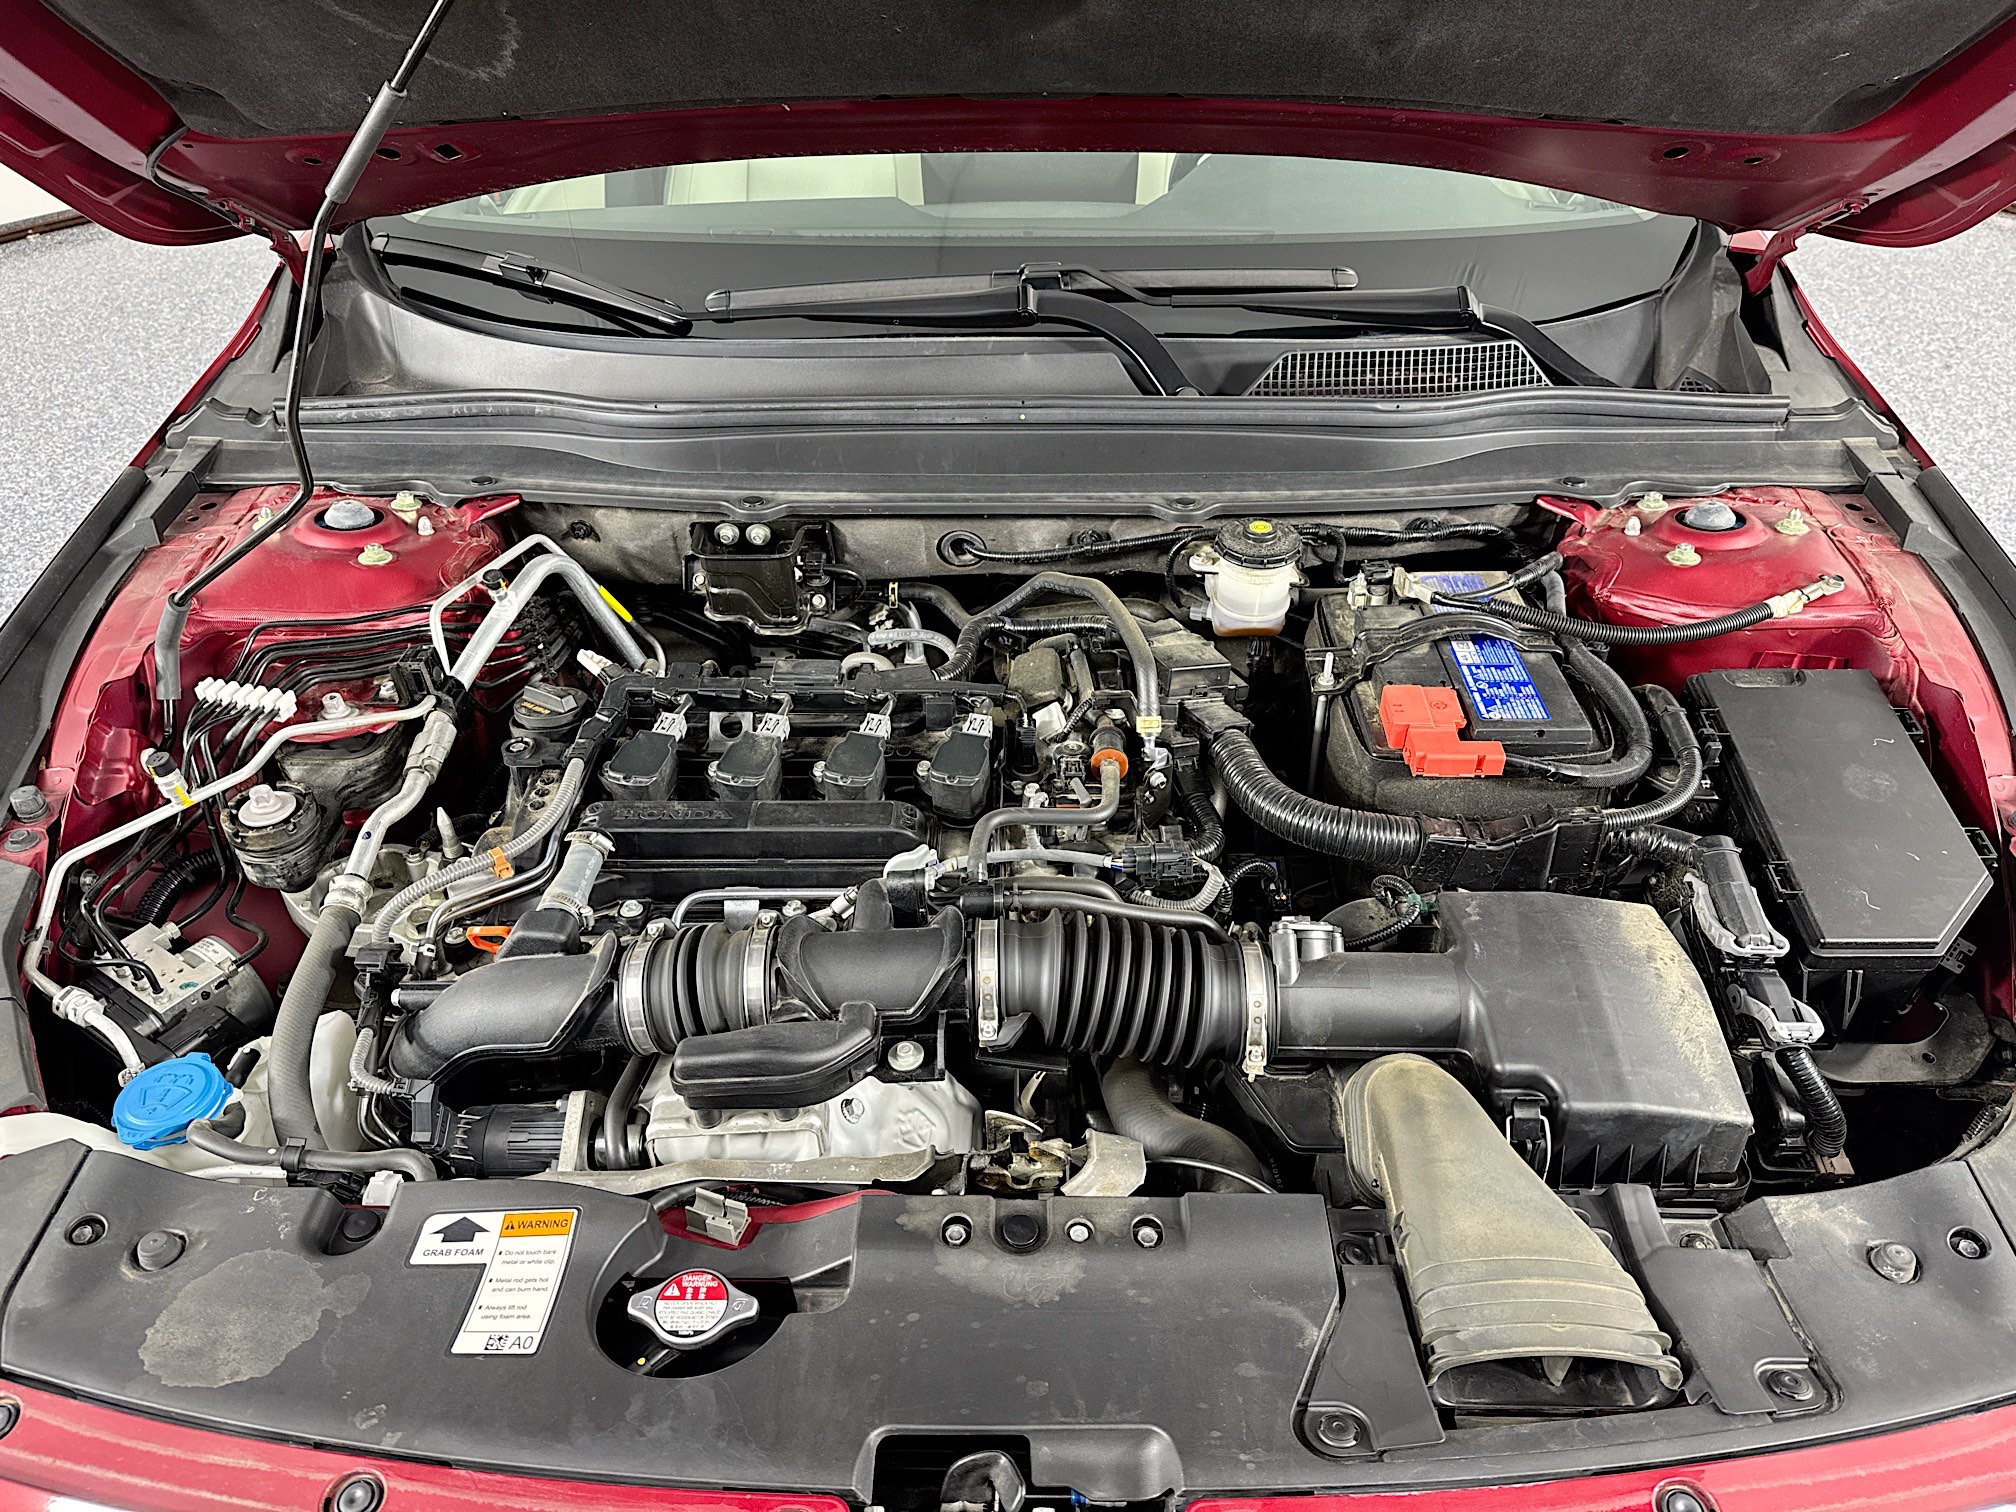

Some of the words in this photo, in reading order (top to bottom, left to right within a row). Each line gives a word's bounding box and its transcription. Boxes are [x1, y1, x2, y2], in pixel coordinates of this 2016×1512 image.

[613, 808, 734, 820] HONDA
[517, 1218, 569, 1230] WARNING
[422, 1248, 453, 1257] GRAB
[454, 1248, 485, 1256] FOAM
